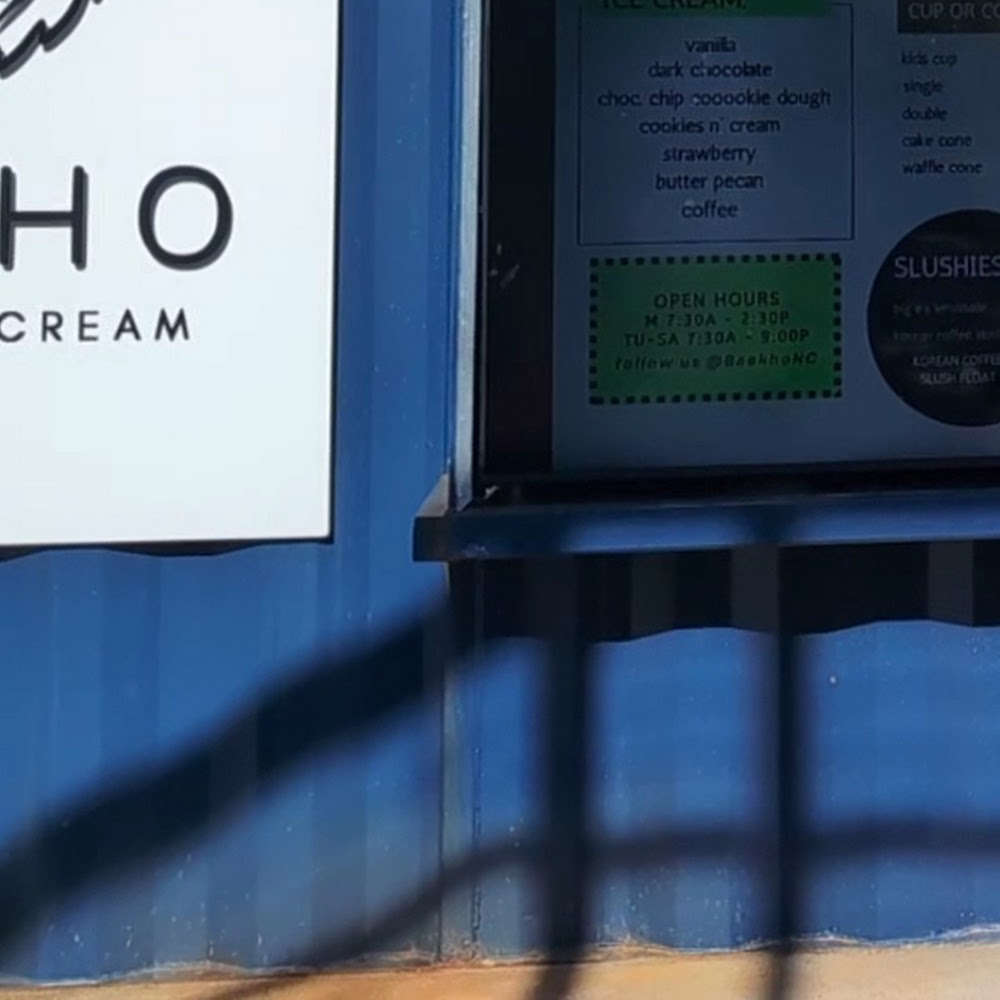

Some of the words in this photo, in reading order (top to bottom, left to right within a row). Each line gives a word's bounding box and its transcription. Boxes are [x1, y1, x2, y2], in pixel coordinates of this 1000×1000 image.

[908, 2, 943, 20] CUP
[950, 2, 975, 19] OR
[685, 36, 736, 53] vanilla
[648, 61, 684, 77] dark
[690, 60, 773, 77] chocolate
[649, 89, 685, 109] chip
[776, 88, 831, 109] dough
[901, 106, 948, 121] double
[639, 117, 704, 135] cookies
[728, 118, 780, 133] cream
[937, 135, 973, 147] cone
[662, 144, 757, 164] strawberry
[948, 161, 983, 174] cone
[656, 174, 707, 190] butter
[713, 172, 763, 192] pecan
[682, 201, 738, 218] coffee
[653, 293, 705, 310] OPEN
[714, 290, 780, 308] HOURS
[0, 308, 189, 342] CREAM
[667, 313, 717, 327] 7:30A
[624, 332, 680, 347] TU-SA
[687, 330, 737, 346] 7:30A
[615, 356, 673, 370] follow
[680, 357, 699, 368] us
